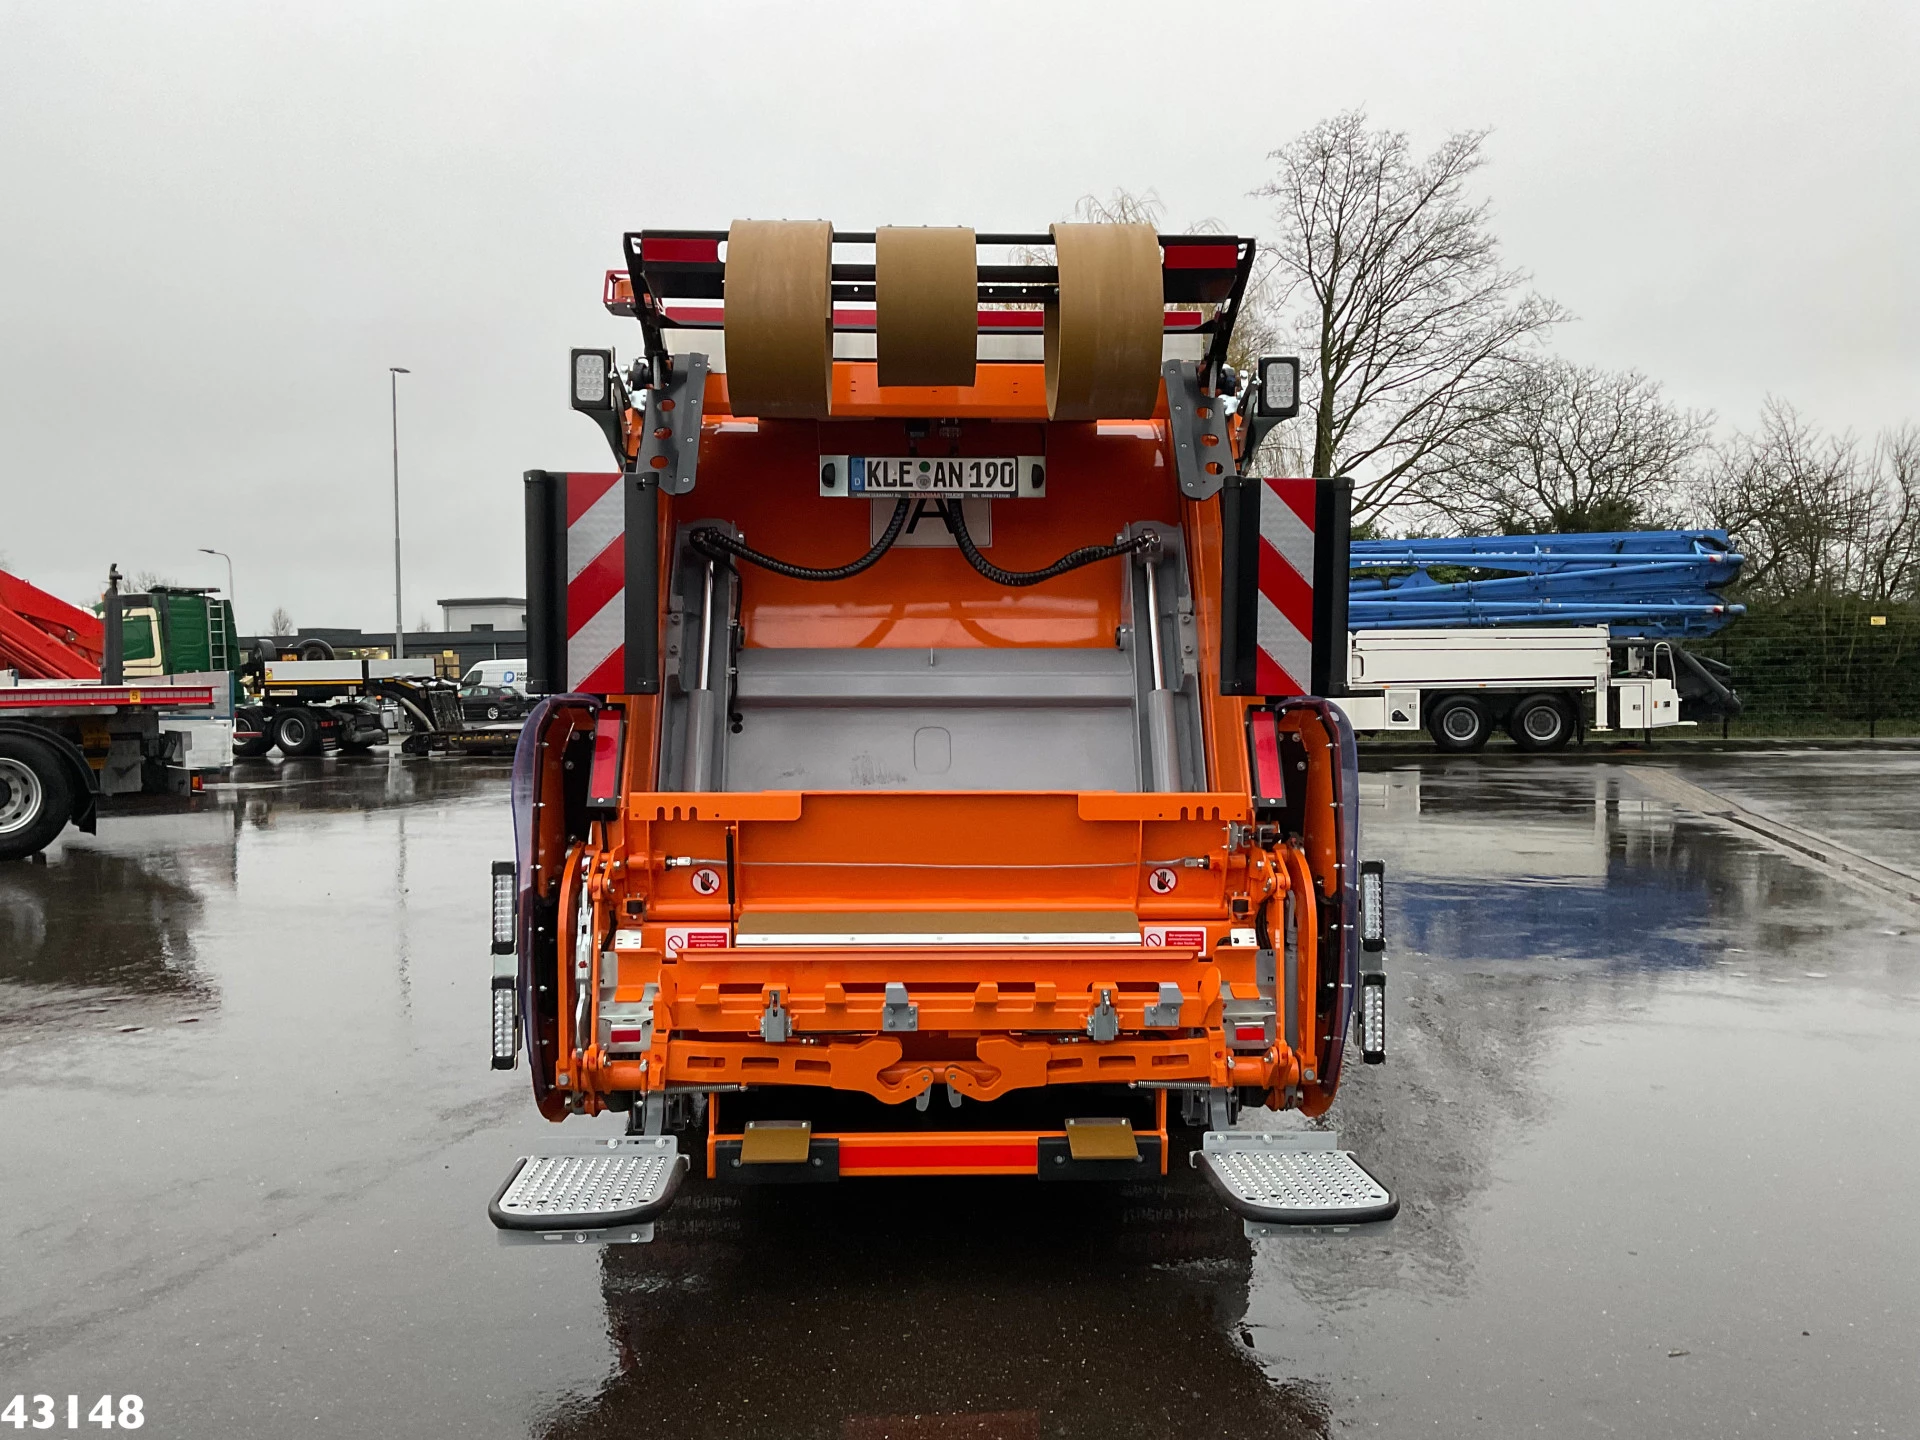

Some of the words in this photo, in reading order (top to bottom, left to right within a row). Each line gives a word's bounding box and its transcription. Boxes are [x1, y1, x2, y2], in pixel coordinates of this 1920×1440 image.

[854, 477, 861, 486] D
[867, 461, 914, 487] KLE
[933, 461, 963, 488] AN
[969, 461, 1014, 488] 190
[905, 499, 956, 534] A
